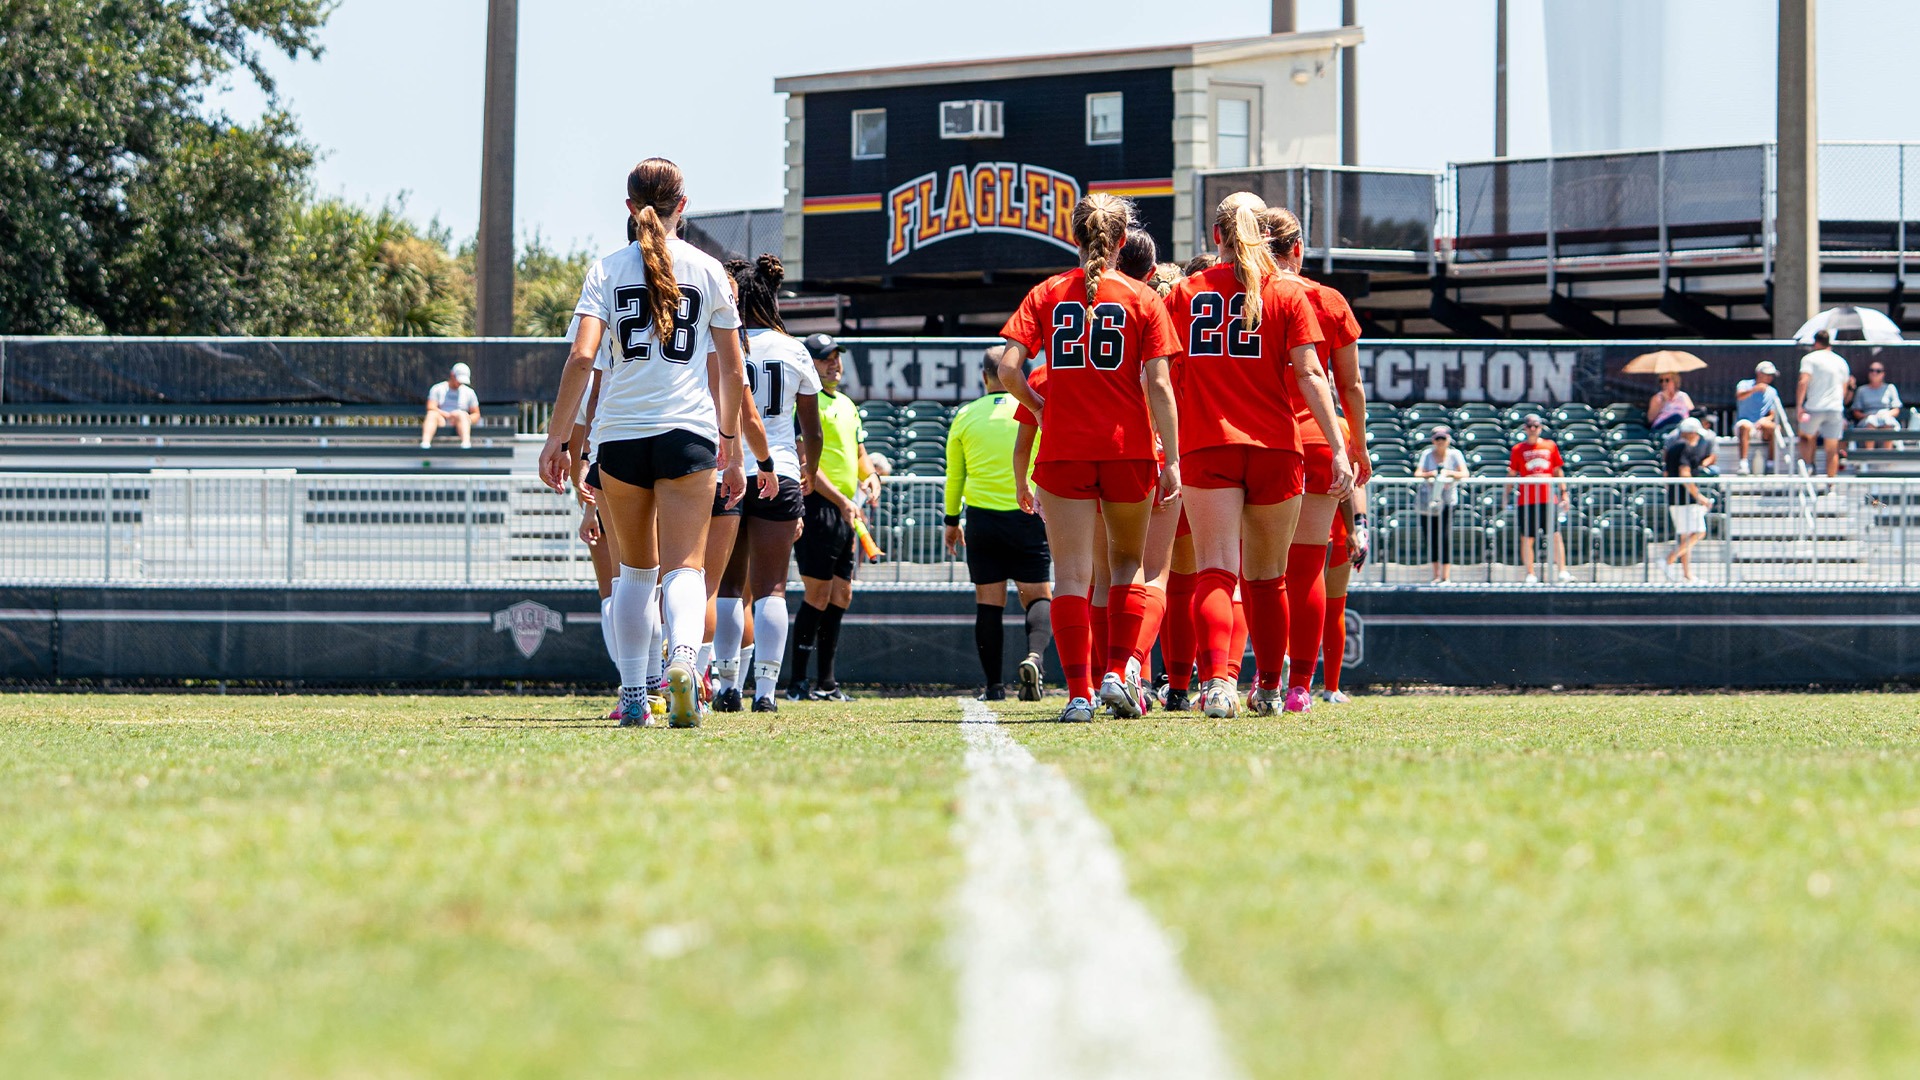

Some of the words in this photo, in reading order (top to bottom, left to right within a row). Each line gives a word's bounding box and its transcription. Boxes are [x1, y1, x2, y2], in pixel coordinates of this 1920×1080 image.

[887, 162, 1080, 263] FLAGLER
[614, 284, 703, 364] 28
[1051, 301, 1126, 370] 26
[1188, 291, 1263, 359] 22
